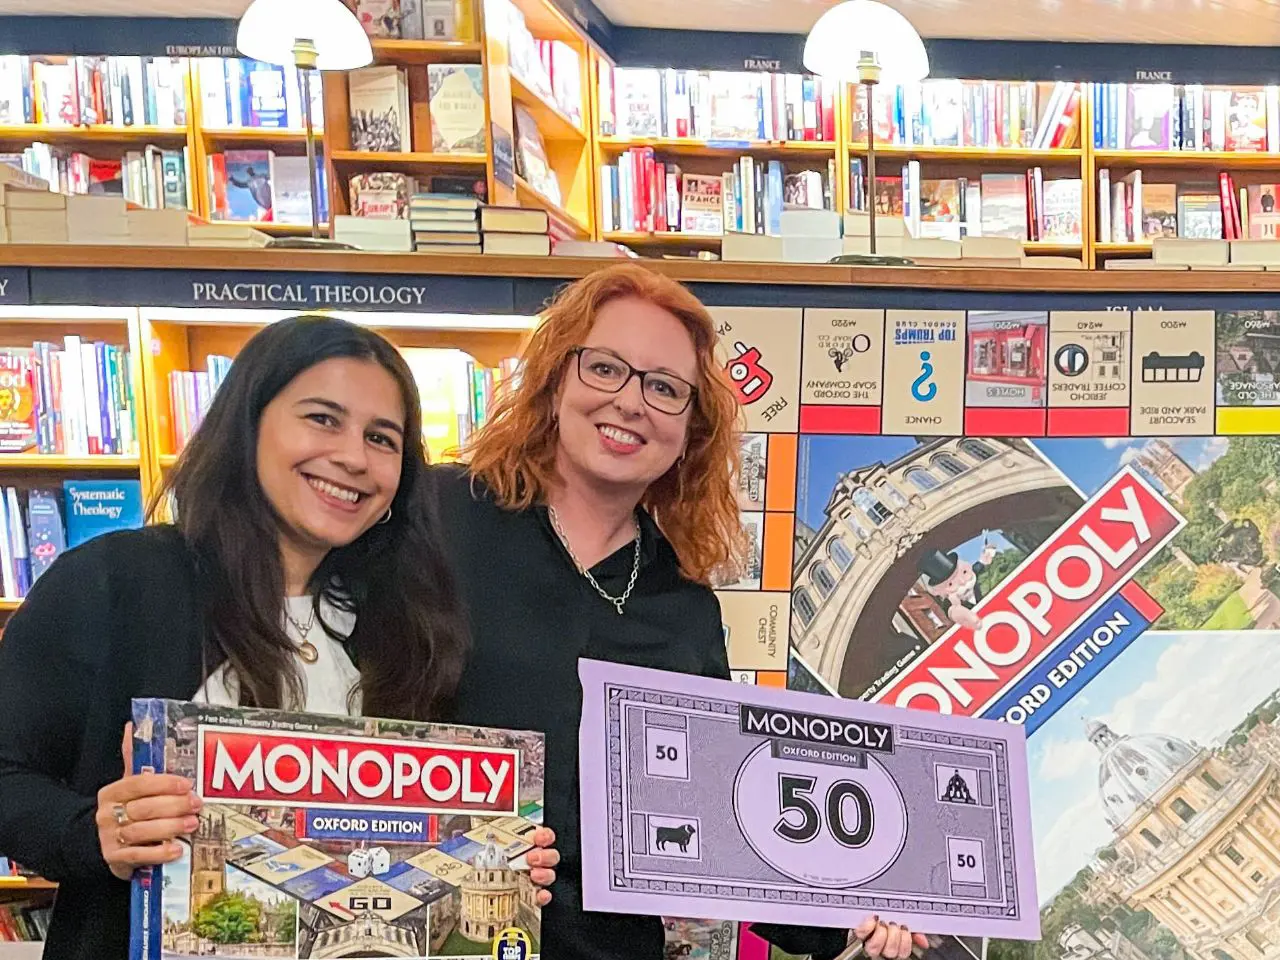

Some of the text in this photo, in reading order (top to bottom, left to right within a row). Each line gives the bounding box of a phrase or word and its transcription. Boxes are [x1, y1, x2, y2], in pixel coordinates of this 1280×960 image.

[744, 59, 780, 70] FRANCE
[1136, 70, 1172, 81] FRANCE
[684, 195, 721, 204] FRANCE
[193, 283, 426, 305] PRACTICAL THEOLOGY
[895, 329, 956, 341] TOP TRUMPS
[806, 381, 877, 390] SOAP COMPANY
[1052, 383, 1126, 391] COFFEE TRADERS
[813, 391, 869, 399] THE OXFORD
[1070, 392, 1107, 400] JERICHO
[1238, 391, 1257, 400] OLD
[761, 397, 788, 422] FREE
[1140, 407, 1206, 415] PARK AND RIDE
[905, 416, 942, 424] CHANCE
[1149, 417, 1196, 425] SEACOURT
[69, 487, 126, 504] Systematic
[895, 485, 1152, 717] ONOPOLY
[758, 617, 767, 644] CHEST
[768, 604, 778, 659] COMMUNITY
[1047, 609, 1131, 689] EDITION
[747, 712, 889, 749] MONOPOLY
[655, 745, 678, 762] 50
[782, 745, 857, 764] OXFORD EDITION
[211, 738, 510, 804] MONOPOLY
[773, 772, 875, 849] 50
[312, 816, 423, 835] OXFORD EDITION
[956, 853, 976, 869] 50
[349, 896, 392, 911] GO
